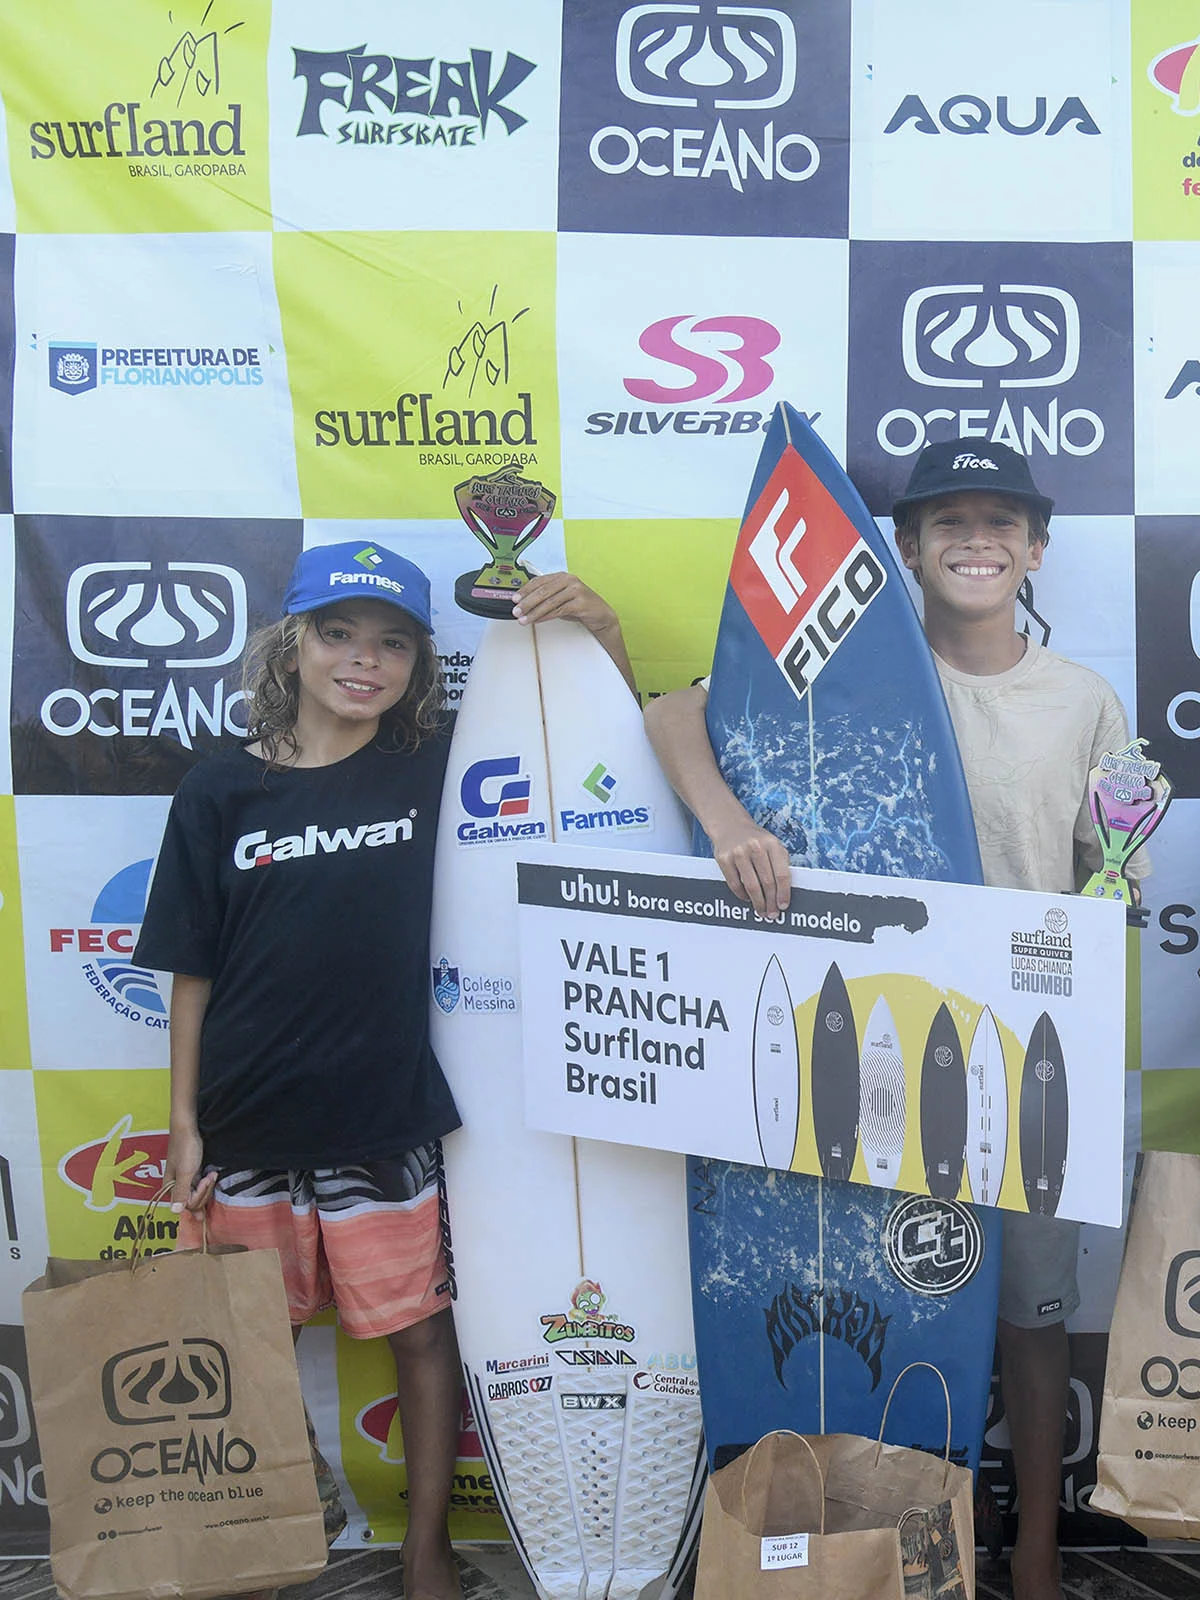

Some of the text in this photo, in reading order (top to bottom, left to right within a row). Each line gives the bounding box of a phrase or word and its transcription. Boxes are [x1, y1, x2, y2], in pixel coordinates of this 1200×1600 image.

[291, 44, 537, 136] FREAK
[883, 94, 1101, 136] AQUA
[30, 103, 246, 160] surfland
[337, 120, 478, 146] SURFSKATE
[589, 117, 820, 193] OCEANO
[129, 163, 246, 179] BRASIL, GAROPABA
[101, 347, 260, 367] PREFEITURA DE
[101, 365, 264, 387] FLORIANÓPOLIS
[315, 392, 537, 446] surfland
[419, 453, 538, 468] BRASIL, GAROPABA
[329, 571, 404, 594] Farmes
[783, 549, 883, 696] FICO
[560, 806, 649, 831] Farmes
[457, 821, 546, 841] Galwan
[234, 817, 414, 871] Galwan
[560, 874, 619, 907] uhu!
[627, 889, 669, 912] bora
[673, 899, 749, 921] escolher
[790, 910, 861, 933] modelo
[1011, 929, 1073, 949] surfland
[560, 938, 670, 982] VALE 1
[1013, 945, 1070, 960] SUPER QUIVER
[1011, 956, 1073, 976] LUCAS CHIANCA
[82, 963, 141, 1021] FEDERAÇÃO
[462, 977, 512, 993] Colégio
[1011, 970, 1073, 998] CHUMBO
[464, 998, 516, 1011] Messina
[563, 980, 730, 1033] PRANCHA
[564, 1021, 705, 1071] Surfland
[566, 1062, 657, 1105] Brasil
[1041, 1302, 1060, 1313] FICO
[486, 1353, 549, 1374] Marcarini
[488, 1379, 529, 1399] CARROS
[654, 1383, 695, 1396] Colchões
[655, 1373, 688, 1386] Central
[563, 1396, 622, 1408] BWX
[1157, 1412, 1197, 1433] keep
[91, 1428, 257, 1487] OCEANO
[116, 1486, 264, 1510] keep the ocean blue
[772, 1542, 798, 1552] SUB 12
[777, 1552, 803, 1561] LUGAR
